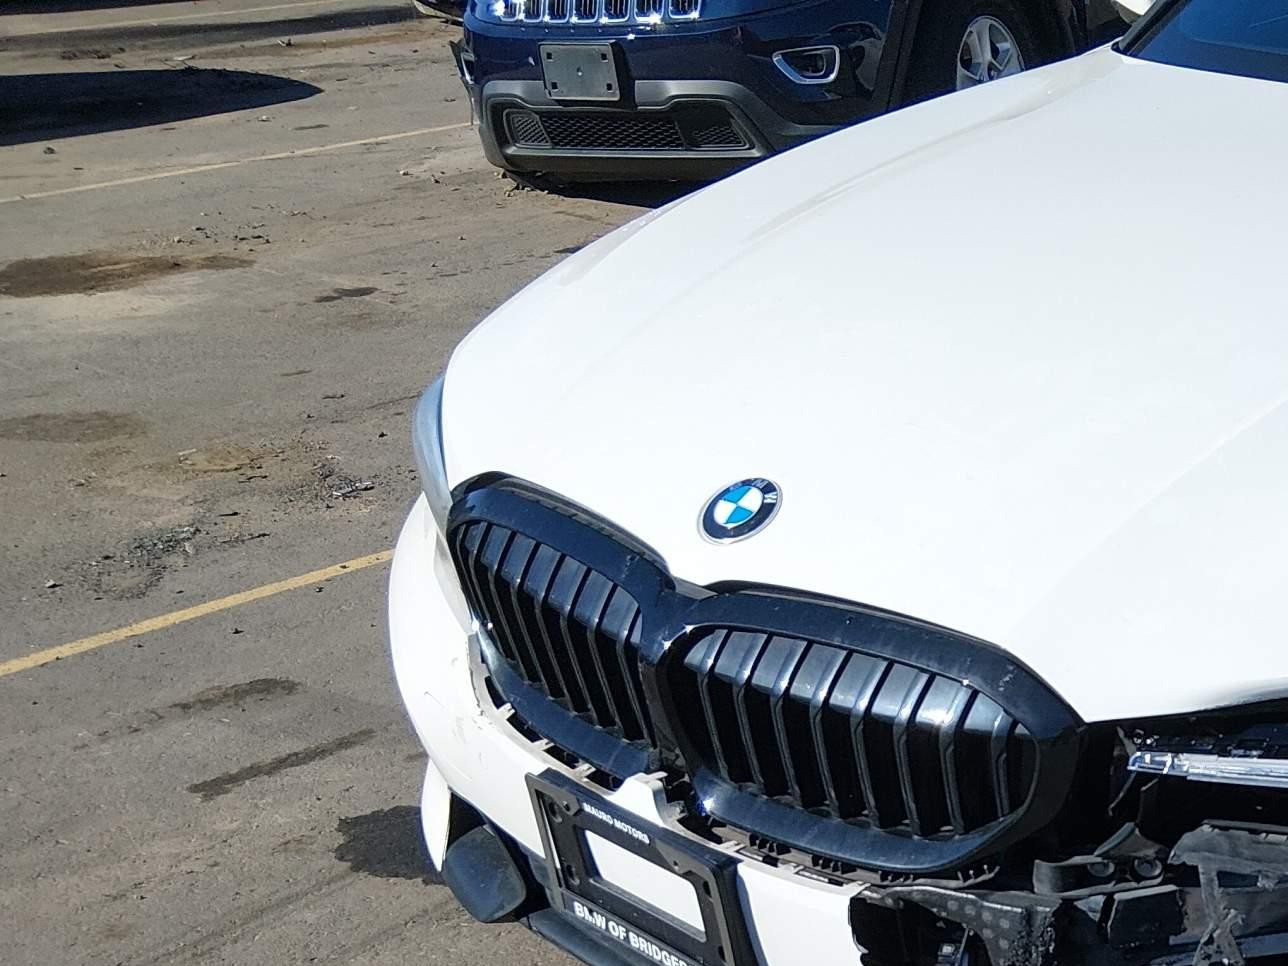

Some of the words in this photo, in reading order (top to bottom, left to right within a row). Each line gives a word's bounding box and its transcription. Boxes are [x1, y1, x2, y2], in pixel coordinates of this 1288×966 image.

[613, 817, 651, 844] MOTORS
[573, 901, 607, 931] BMW
[608, 920, 628, 941] OF
